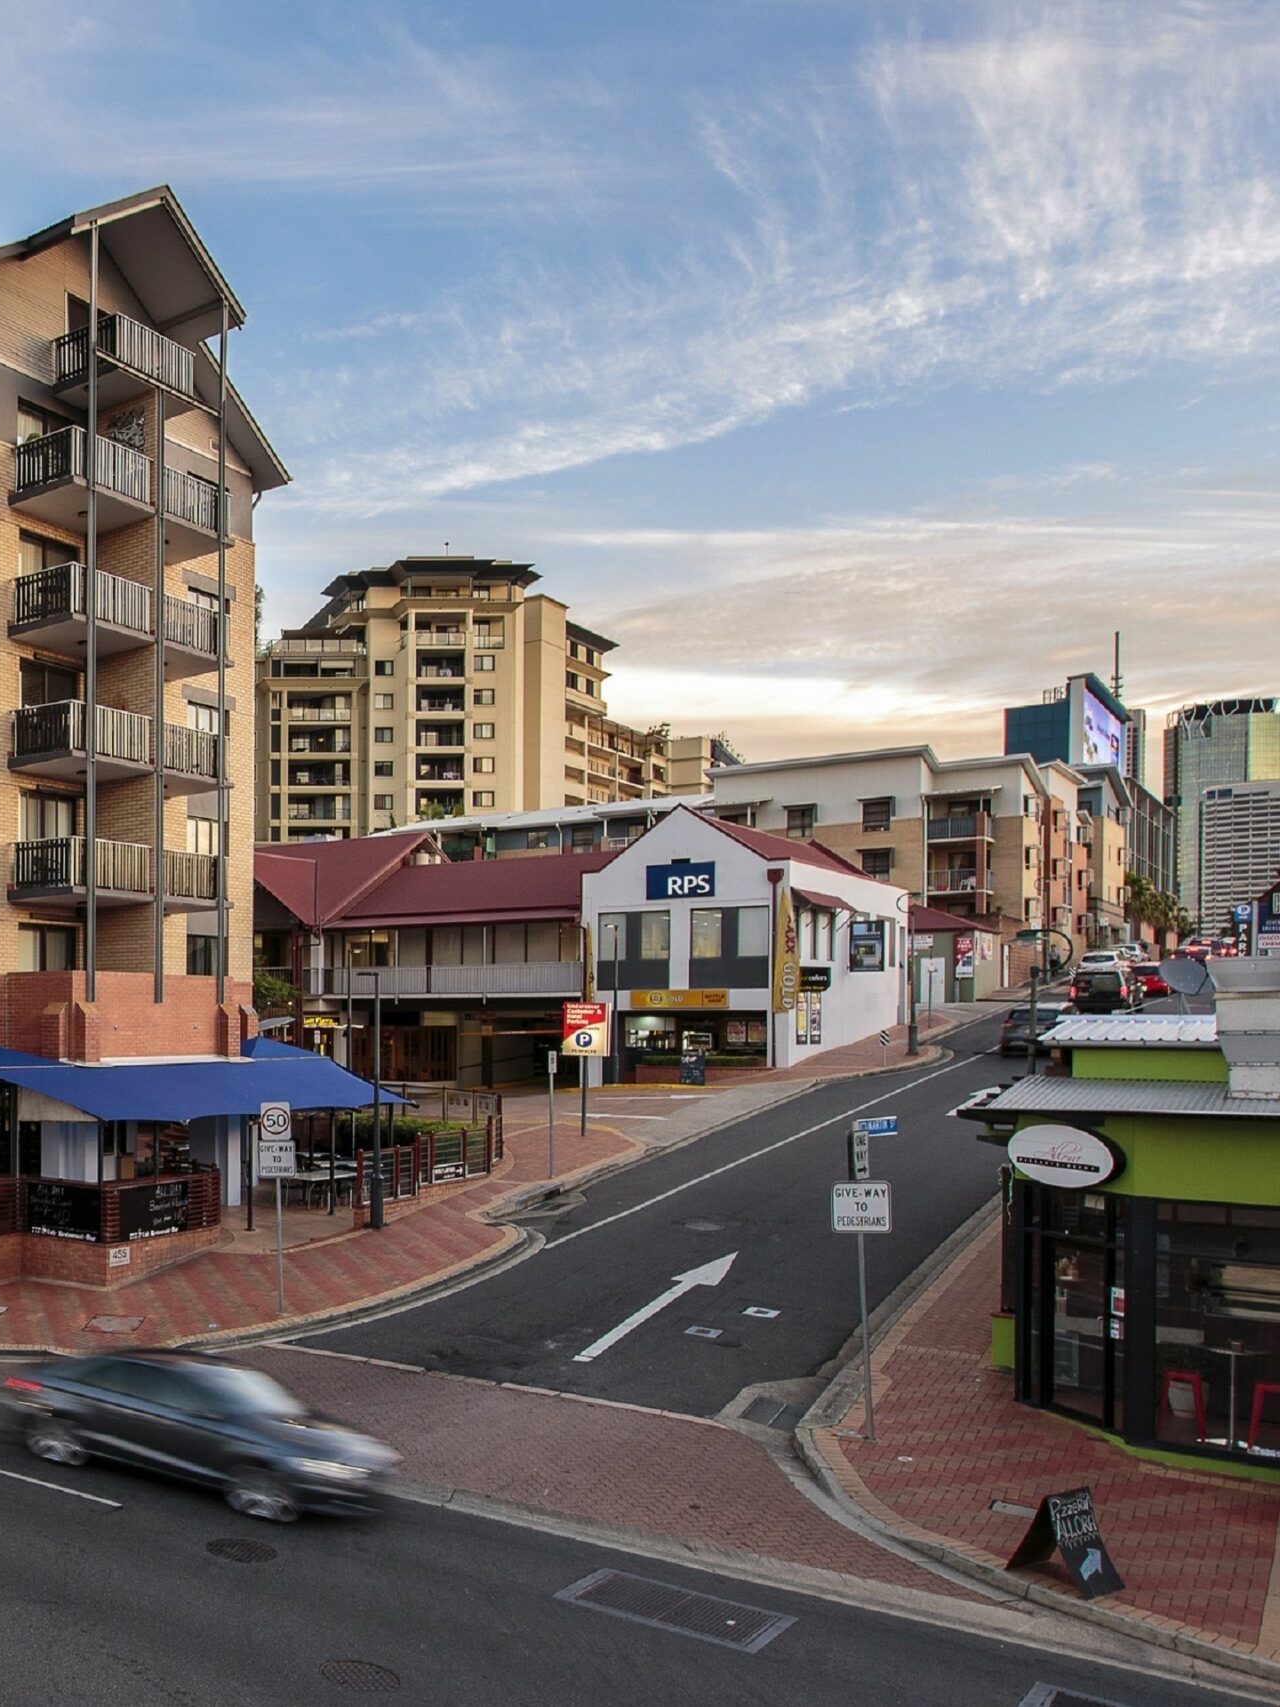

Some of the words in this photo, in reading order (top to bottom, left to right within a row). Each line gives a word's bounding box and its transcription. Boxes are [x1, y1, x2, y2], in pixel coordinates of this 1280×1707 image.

[667, 874, 710, 895] RPS
[782, 961, 796, 1009] GOLD
[266, 1114, 287, 1128] 50
[855, 1135, 867, 1147] ONE
[261, 1145, 293, 1153] GIVE-WAY
[272, 1155, 282, 1163] TO
[261, 1165, 294, 1174] PEDESTRIANS
[835, 1187, 887, 1198] GIVE-WAY
[854, 1201, 868, 1212] TO
[836, 1216, 887, 1227] PEDESTRIANS
[112, 1248, 128, 1260] 455
[1056, 1514, 1098, 1541] ALLORA
